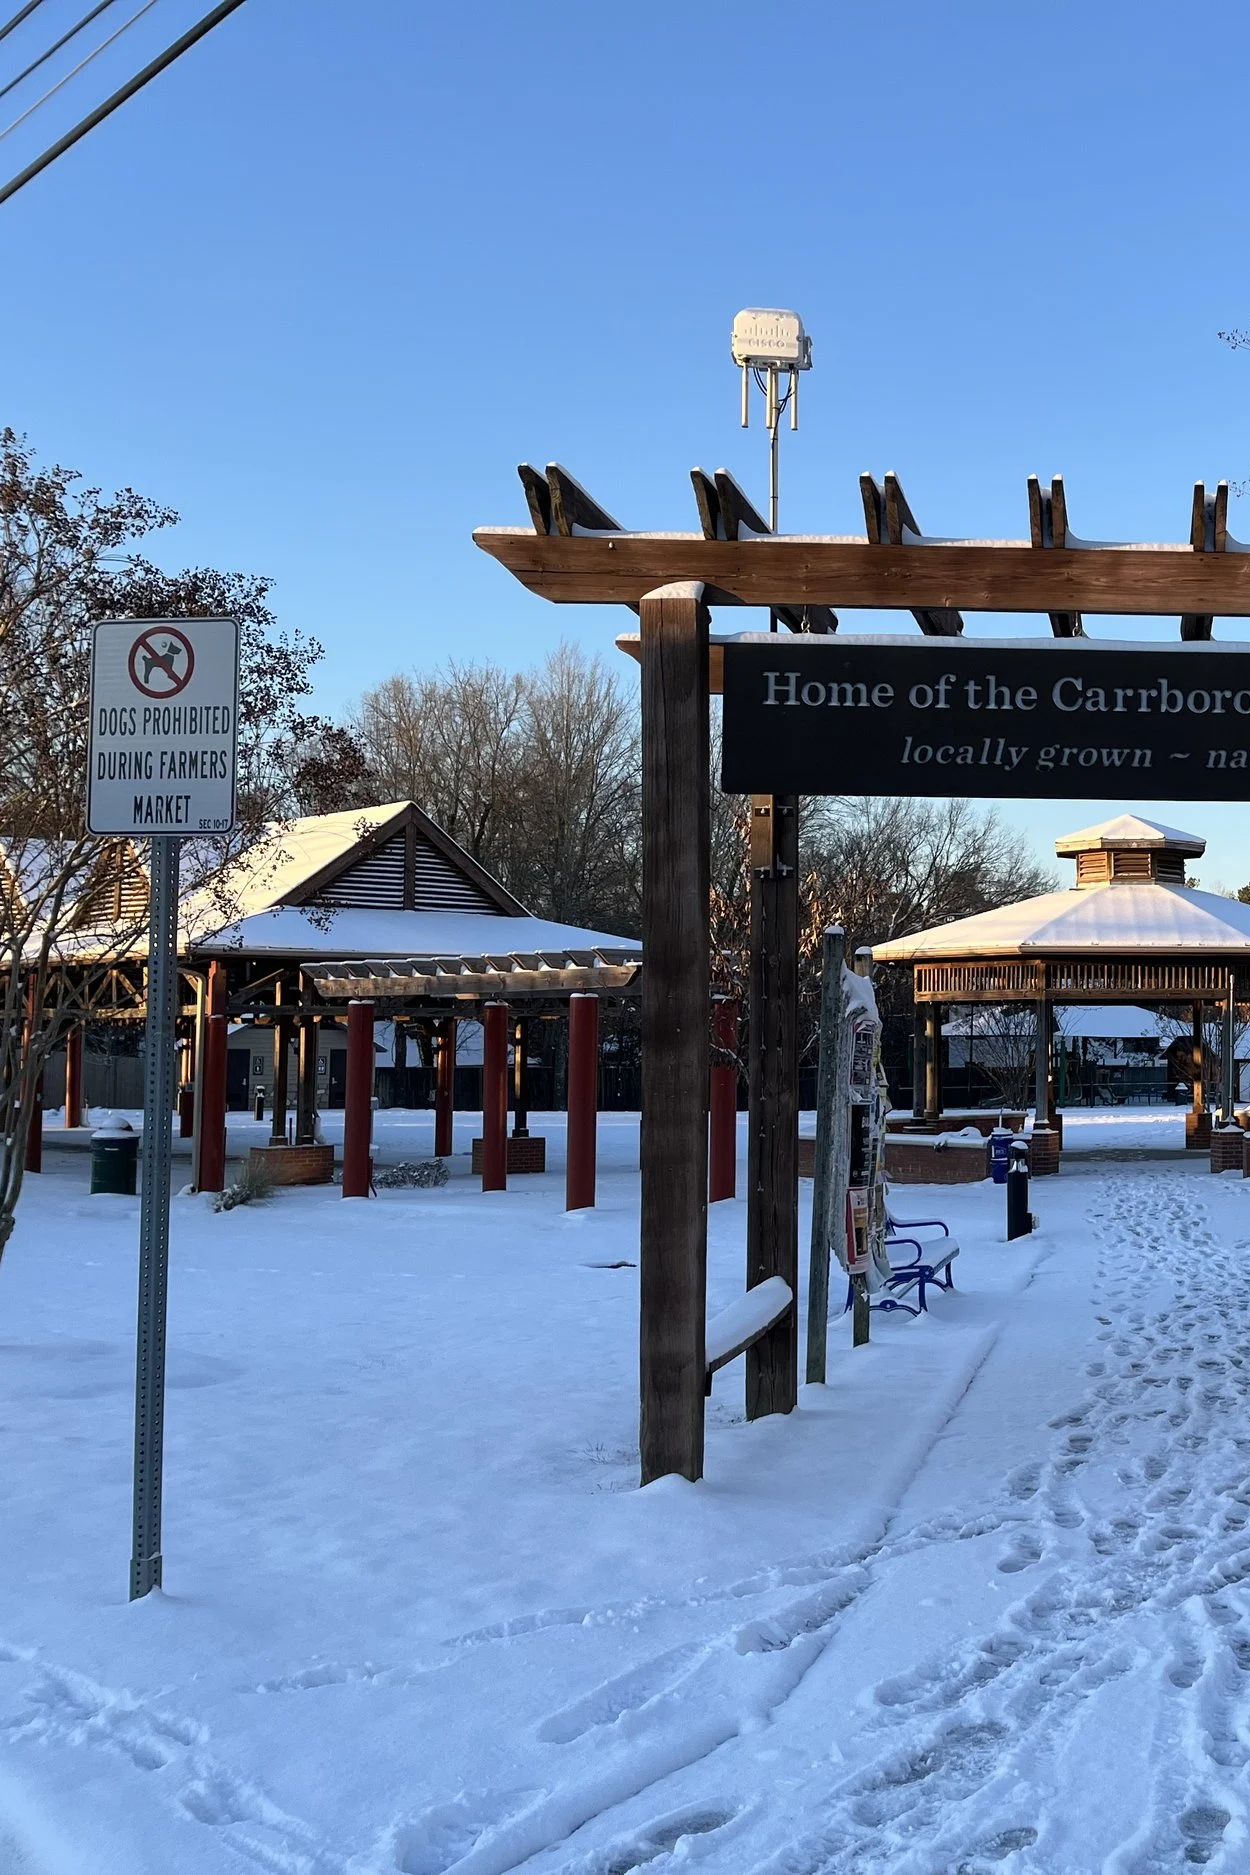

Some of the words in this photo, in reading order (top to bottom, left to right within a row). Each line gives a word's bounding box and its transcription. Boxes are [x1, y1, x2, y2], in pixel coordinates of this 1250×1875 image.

[748, 338, 785, 348] CISCO
[762, 671, 895, 708] Home
[908, 674, 957, 710] of
[964, 675, 1038, 711] the
[99, 707, 137, 737] DOGS
[143, 705, 231, 736] PROHIBITED
[97, 751, 153, 781] DURING
[159, 750, 228, 780] FARMERS
[900, 736, 1030, 772] locally
[1036, 743, 1153, 772] grown
[132, 794, 191, 825] MARKET
[198, 818, 212, 830] SEC
